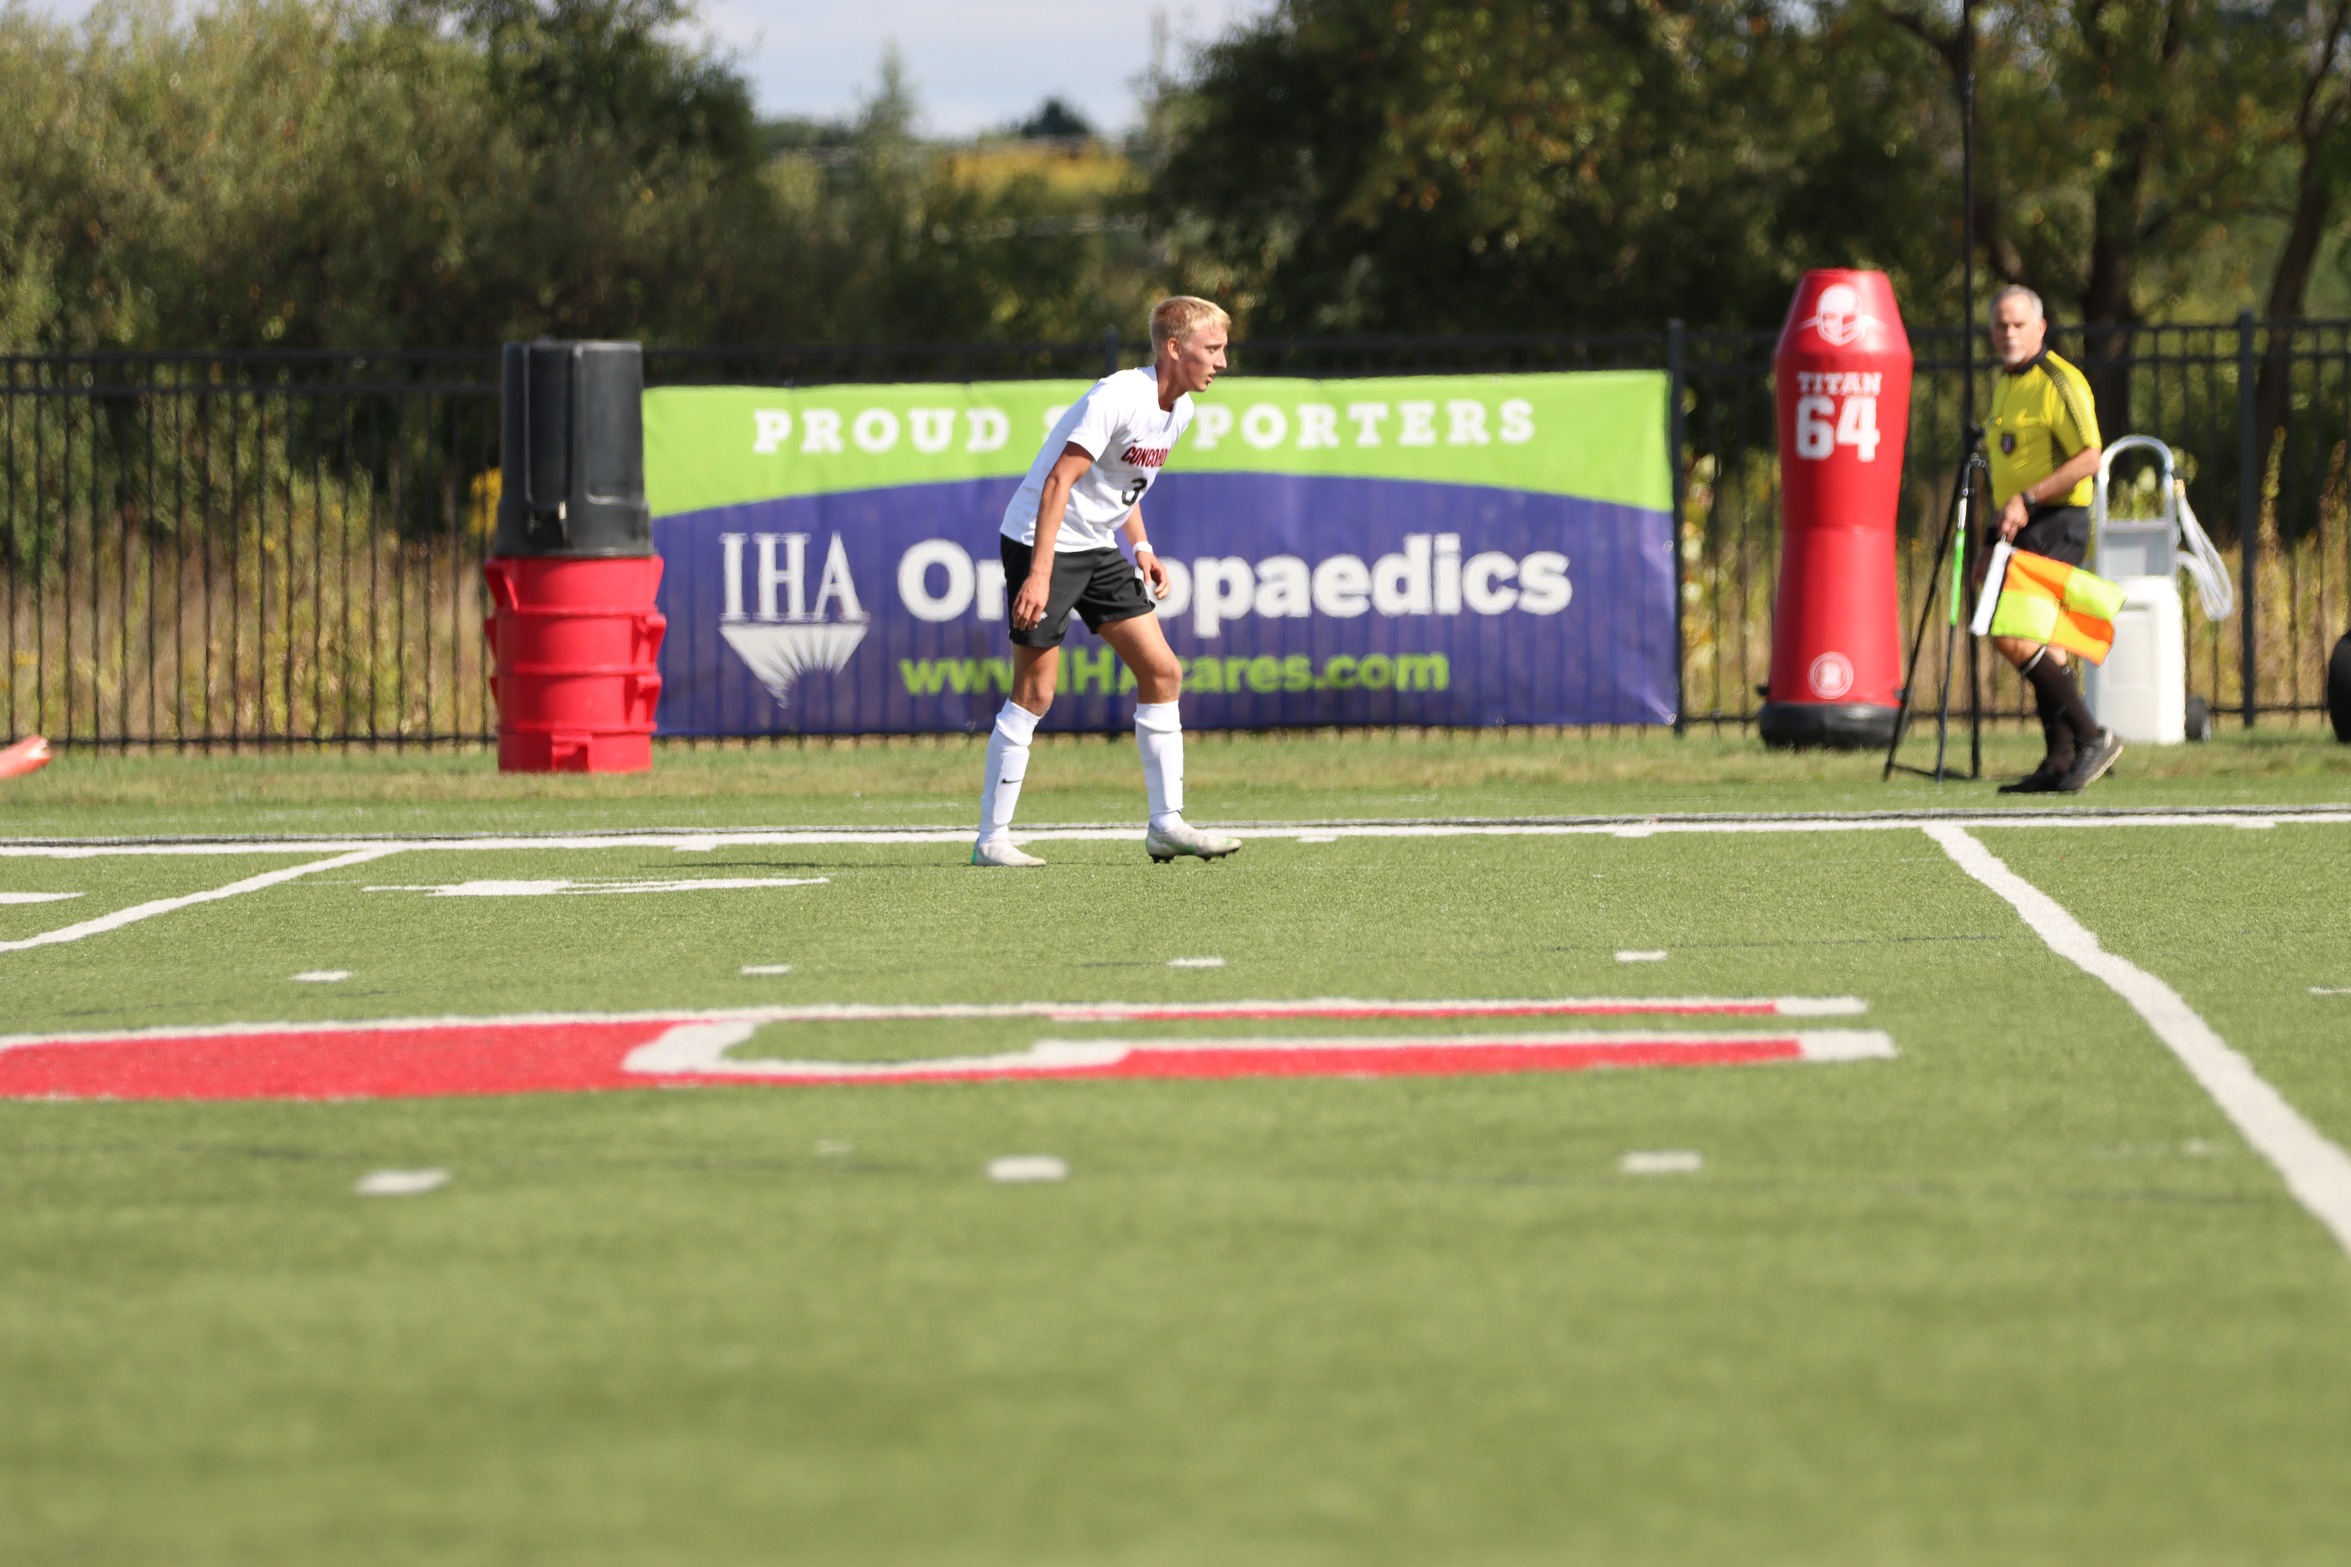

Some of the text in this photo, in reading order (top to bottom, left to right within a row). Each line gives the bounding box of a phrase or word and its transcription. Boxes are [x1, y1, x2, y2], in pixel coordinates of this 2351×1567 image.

[1797, 371, 1883, 396] TITAN
[753, 397, 1536, 454] PROUD PORTERS
[1795, 394, 1881, 462] 64
[1121, 477, 1148, 507] 3
[718, 530, 871, 623] IHA
[897, 532, 1573, 640] Oropaedics
